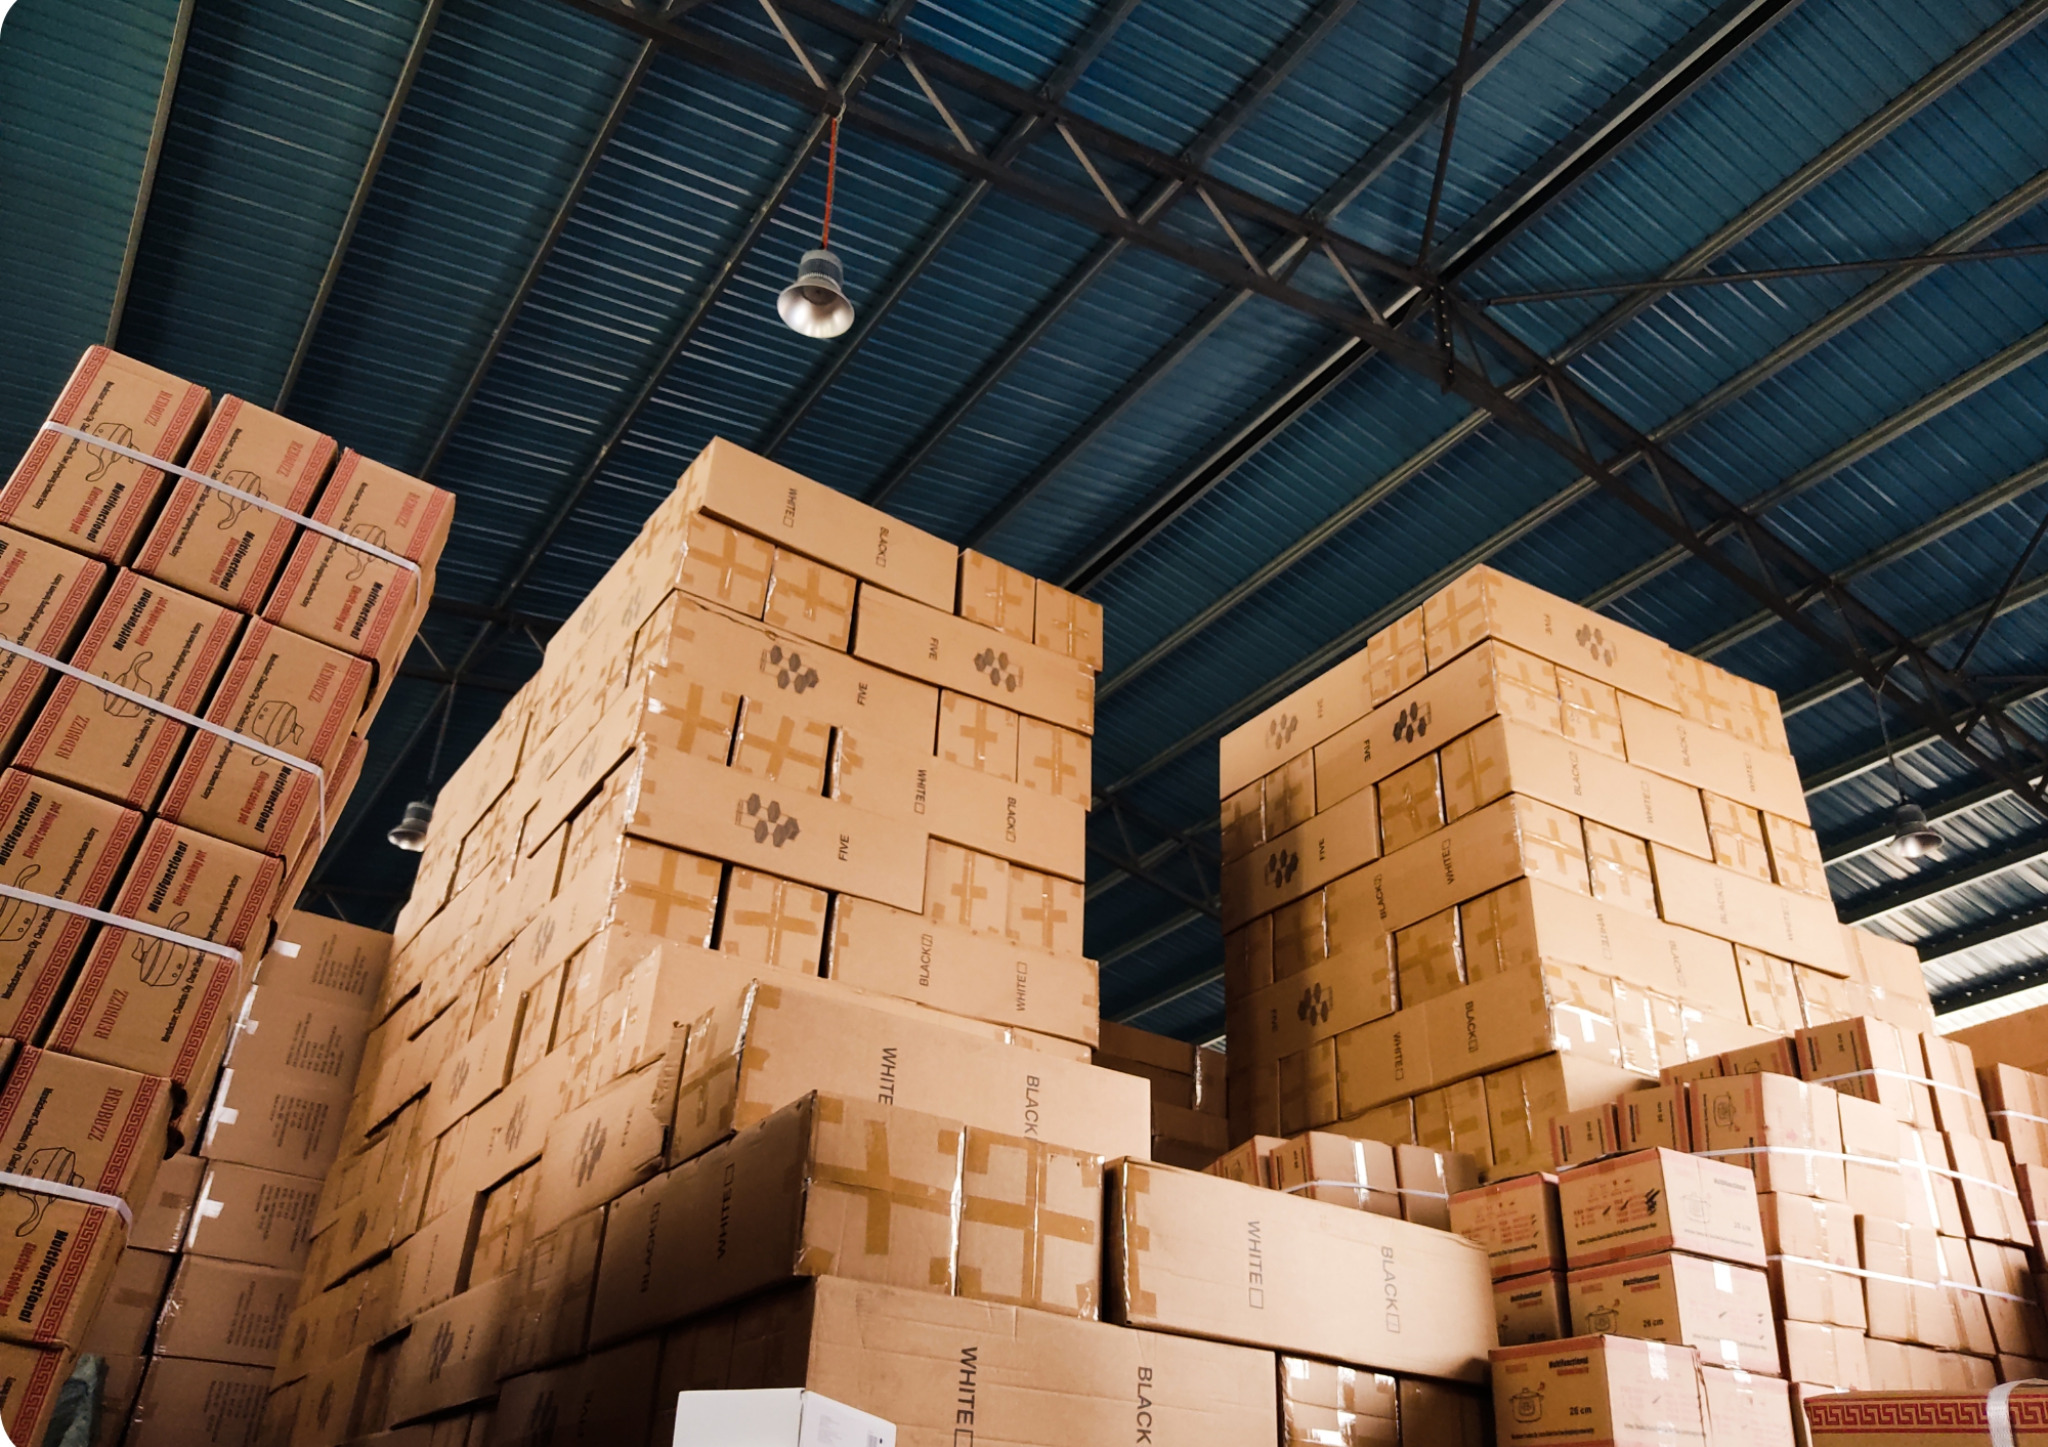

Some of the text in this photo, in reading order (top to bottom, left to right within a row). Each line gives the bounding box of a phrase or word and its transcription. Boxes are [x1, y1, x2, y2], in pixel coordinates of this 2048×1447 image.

[85, 481, 126, 543] Multifunctional
[785, 488, 797, 517] WHITE
[217, 530, 257, 592] Multifunctional
[878, 526, 889, 557] BLACK
[111, 586, 153, 651] Multifunctional
[348, 580, 384, 640] Multifunctional
[929, 636, 939, 660] FIVE
[857, 682, 868, 706] FIVE
[54, 711, 90, 761] REDBUZZ
[251, 764, 295, 833] Multifunctional
[915, 769, 927, 802] WHITE
[1571, 762, 1582, 796] BLACK
[0, 789, 42, 868] Multifunctional
[21, 800, 62, 860] Electric cooking pot
[1007, 796, 1017, 829] BLACK
[838, 834, 849, 861] FIVE
[1442, 852, 1455, 885] WHITE
[147, 839, 189, 914] Multifunctional
[1375, 886, 1387, 920] BLACK
[919, 946, 931, 987] BLACK
[1016, 974, 1026, 1011] WHITE
[92, 986, 129, 1042] REDBUZZ
[1465, 1001, 1476, 1038] BLACK
[878, 1048, 897, 1105] WHITE
[1393, 1031, 1403, 1069] WHITE
[86, 1087, 123, 1143] REDBUZZ
[1025, 1075, 1039, 1135] BLACK
[717, 1188, 732, 1261] WHITE
[13, 1242, 37, 1272] Electric
[17, 1228, 69, 1323] Multifunctional
[1248, 1221, 1263, 1285] WHITE
[1381, 1246, 1398, 1311] BLACK
[0, 1271, 23, 1303] cooking
[957, 1347, 978, 1424] WHITE
[1136, 1366, 1152, 1444] BLACK
